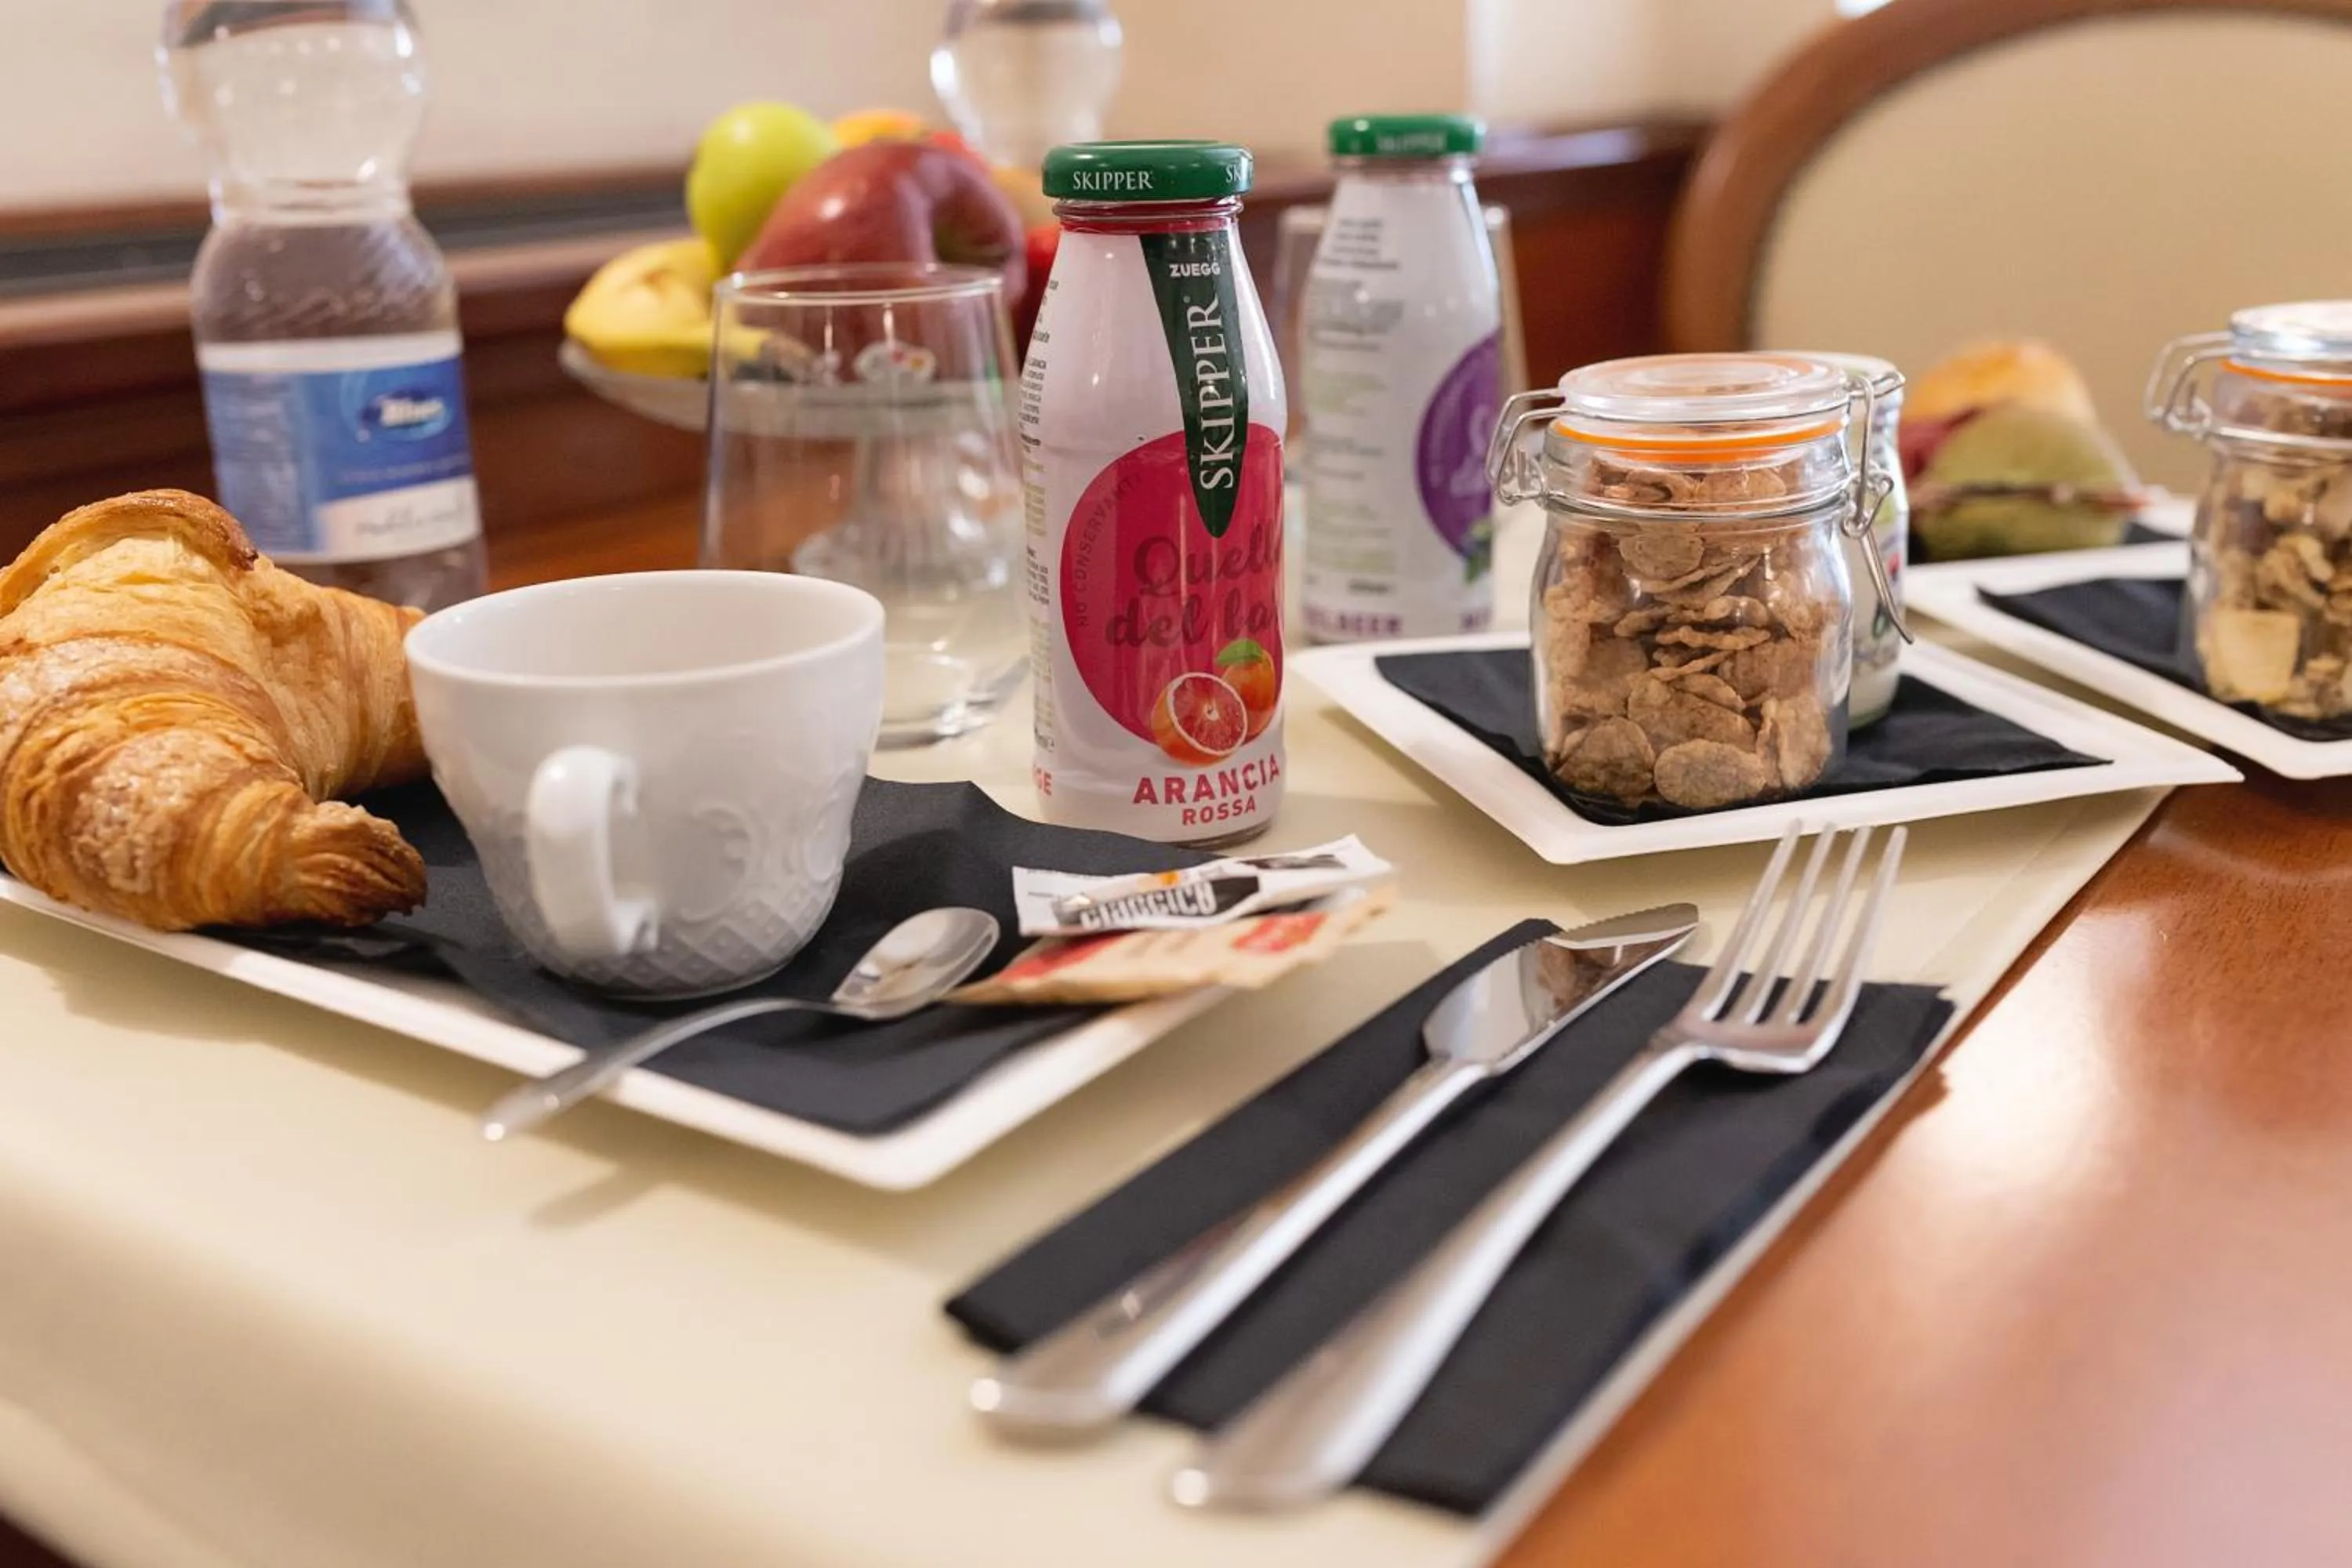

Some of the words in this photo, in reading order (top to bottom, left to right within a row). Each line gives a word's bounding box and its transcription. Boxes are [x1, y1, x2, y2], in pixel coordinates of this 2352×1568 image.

[1073, 170, 1154, 191] SKIPPER
[1169, 262, 1221, 278] ZUEGG
[1185, 292, 1235, 490] SKIPPER
[1105, 593, 1209, 648] del
[1133, 753, 1279, 805] ARANCIA
[1181, 795, 1256, 826] ROSSA
